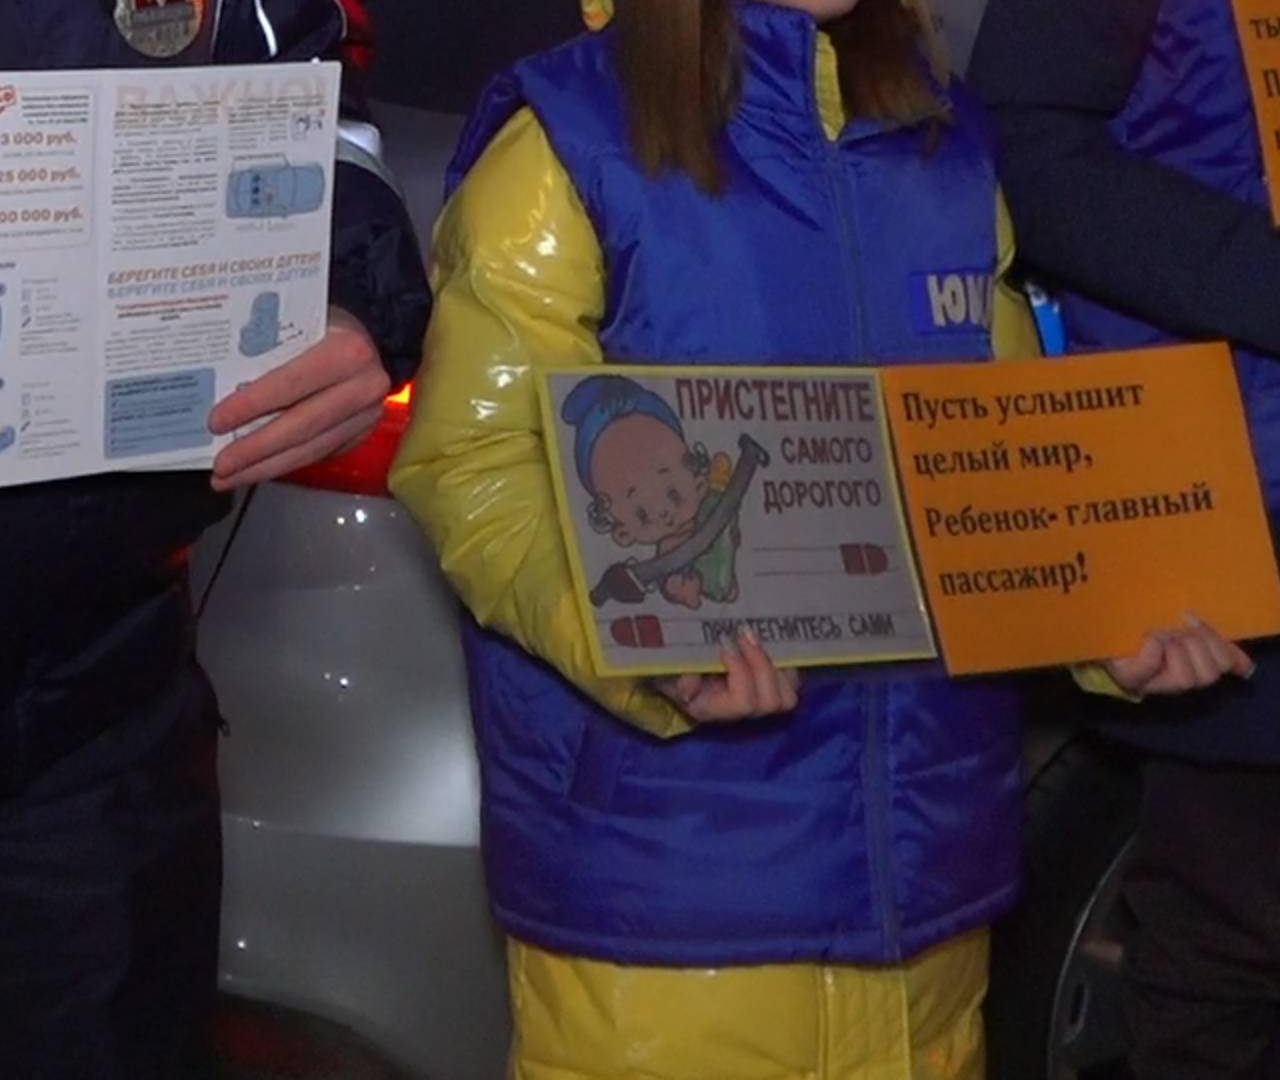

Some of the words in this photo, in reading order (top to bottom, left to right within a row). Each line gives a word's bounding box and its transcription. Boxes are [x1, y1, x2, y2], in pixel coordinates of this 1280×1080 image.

[0, 132, 10, 146] 3
[13, 132, 43, 145] 000
[18, 168, 47, 182] 000
[21, 208, 50, 222] 000
[926, 273, 992, 327] ЮИ
[675, 378, 874, 421] ПРИСТЕГНИТЕ
[902, 391, 988, 429] Пусть
[995, 384, 1144, 424] услышит
[781, 437, 872, 463] САМОГО
[913, 441, 1010, 480] целый
[1019, 442, 1093, 473] мир,
[763, 480, 881, 514] ДОРОГОГО
[924, 505, 1057, 537] Ребенок-
[1065, 483, 1214, 525] главный
[939, 551, 1089, 596] пассажир!
[701, 616, 842, 645] ПРИТЕГНИТЕСЬ
